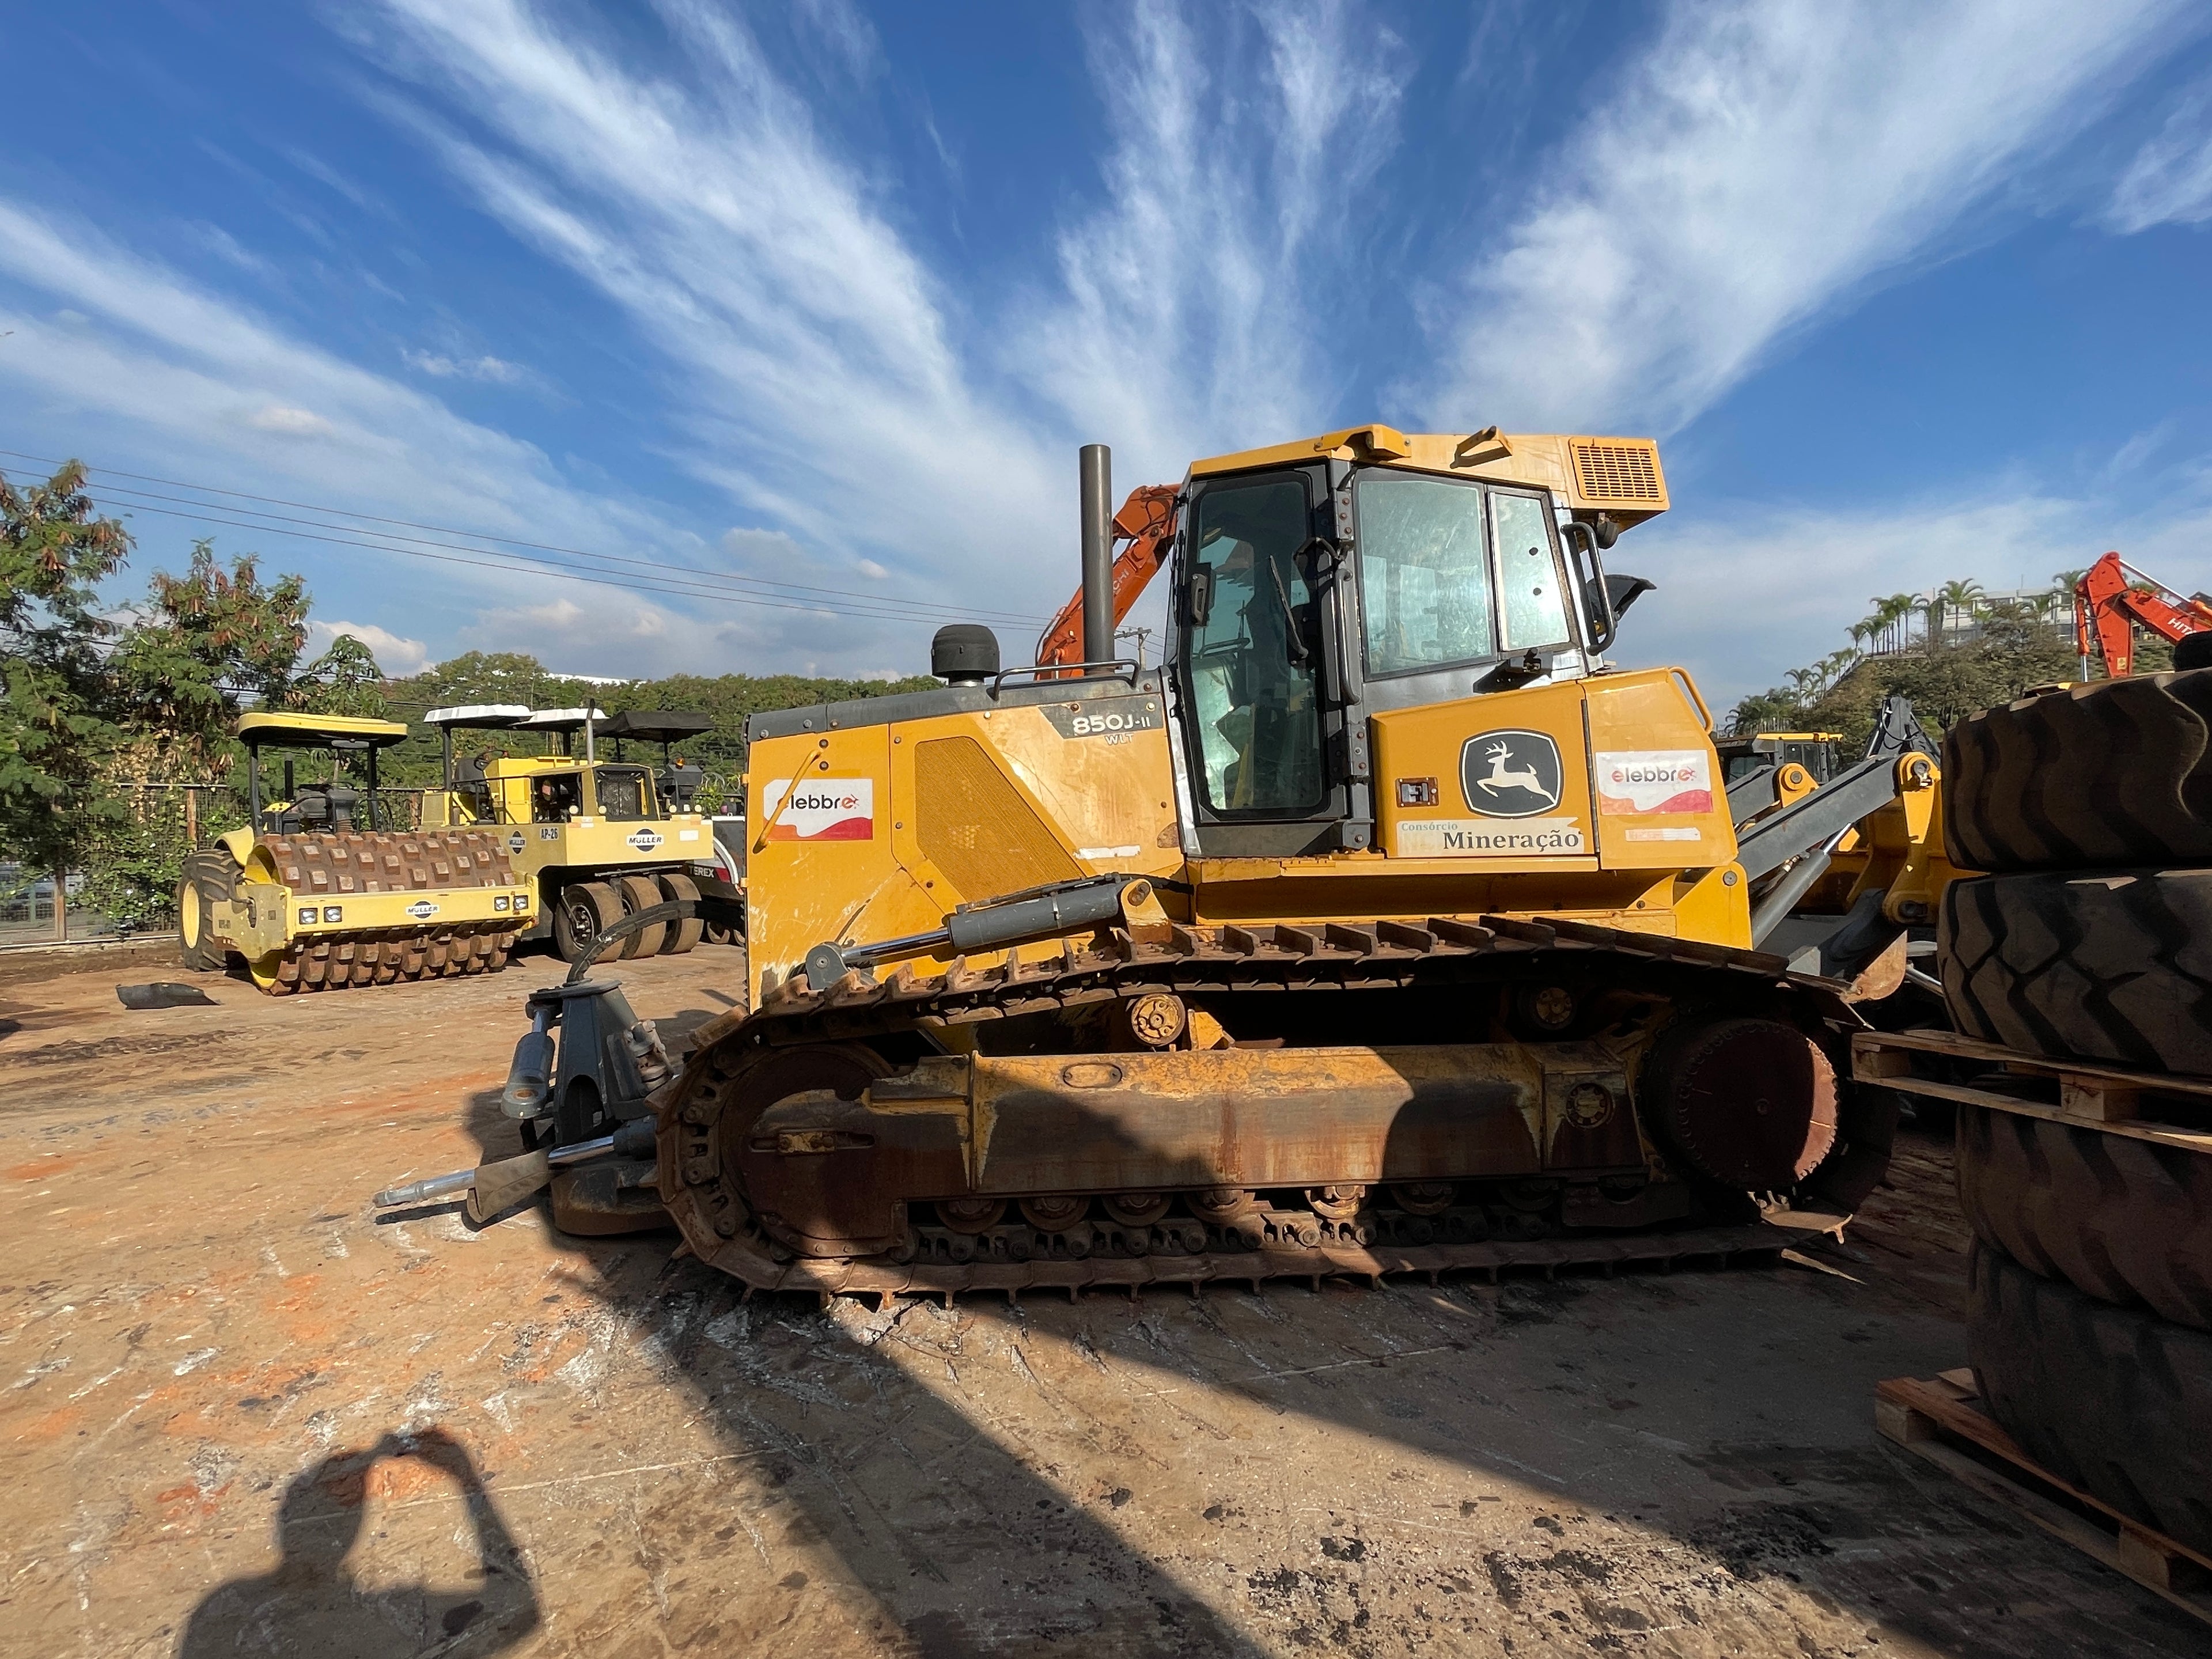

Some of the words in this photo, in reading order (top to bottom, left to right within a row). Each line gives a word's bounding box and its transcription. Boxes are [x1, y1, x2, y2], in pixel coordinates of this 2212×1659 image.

[1104, 733, 1134, 745] WLT
[1612, 766, 1692, 782] elebbre
[1402, 822, 1458, 831] Consórcio
[541, 828, 558, 839] AP-26
[1443, 830, 1580, 852] Mineração
[688, 865, 714, 878] TEREX
